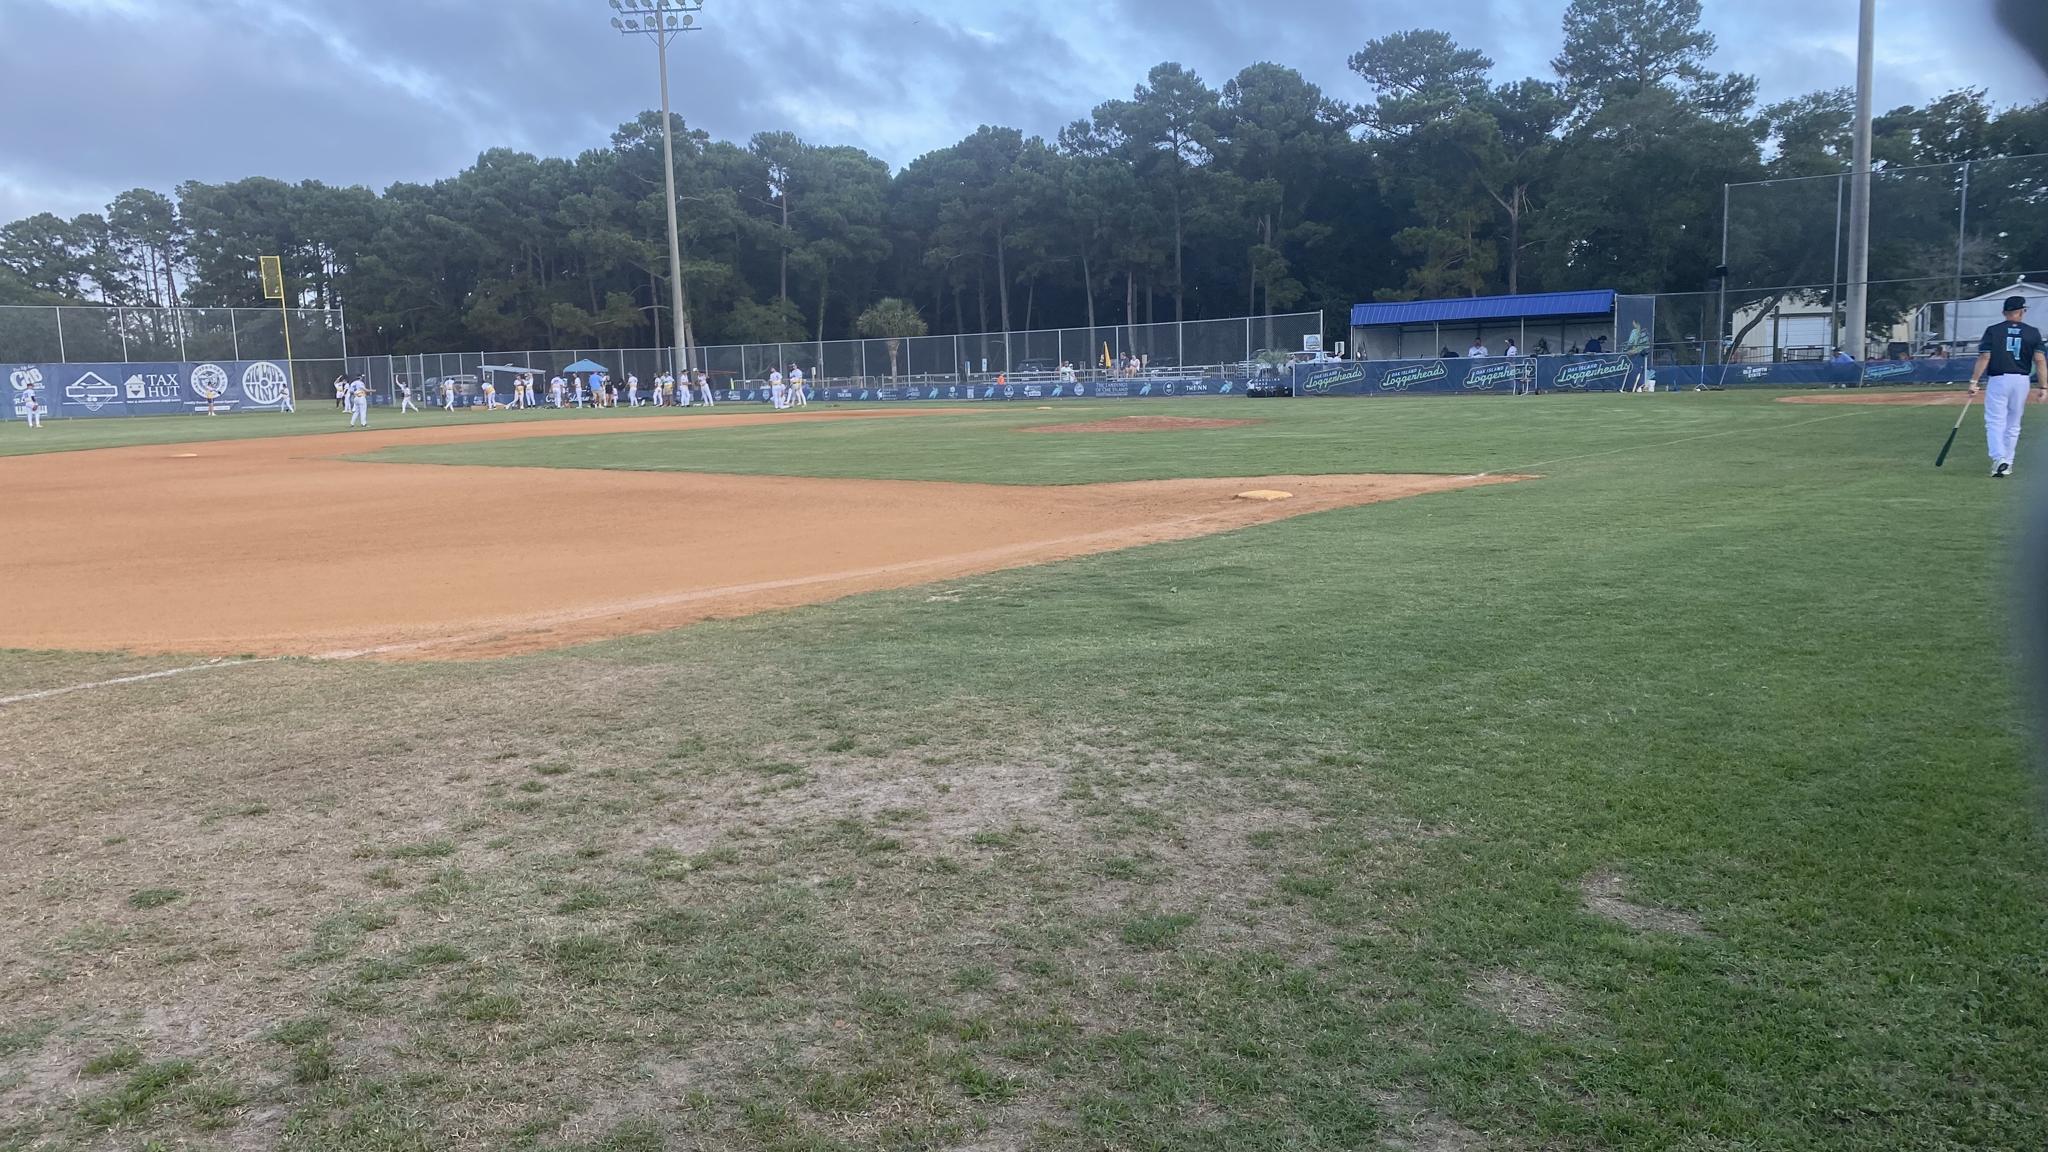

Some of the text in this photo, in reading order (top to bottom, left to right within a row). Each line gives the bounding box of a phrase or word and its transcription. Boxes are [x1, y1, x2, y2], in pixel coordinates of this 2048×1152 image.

[146, 374, 179, 386] TAX
[1306, 366, 1363, 389] Loggerheads
[1383, 364, 1445, 388] Loggerheads
[1557, 359, 1630, 384] Loggerheads
[148, 386, 180, 398] HUT
